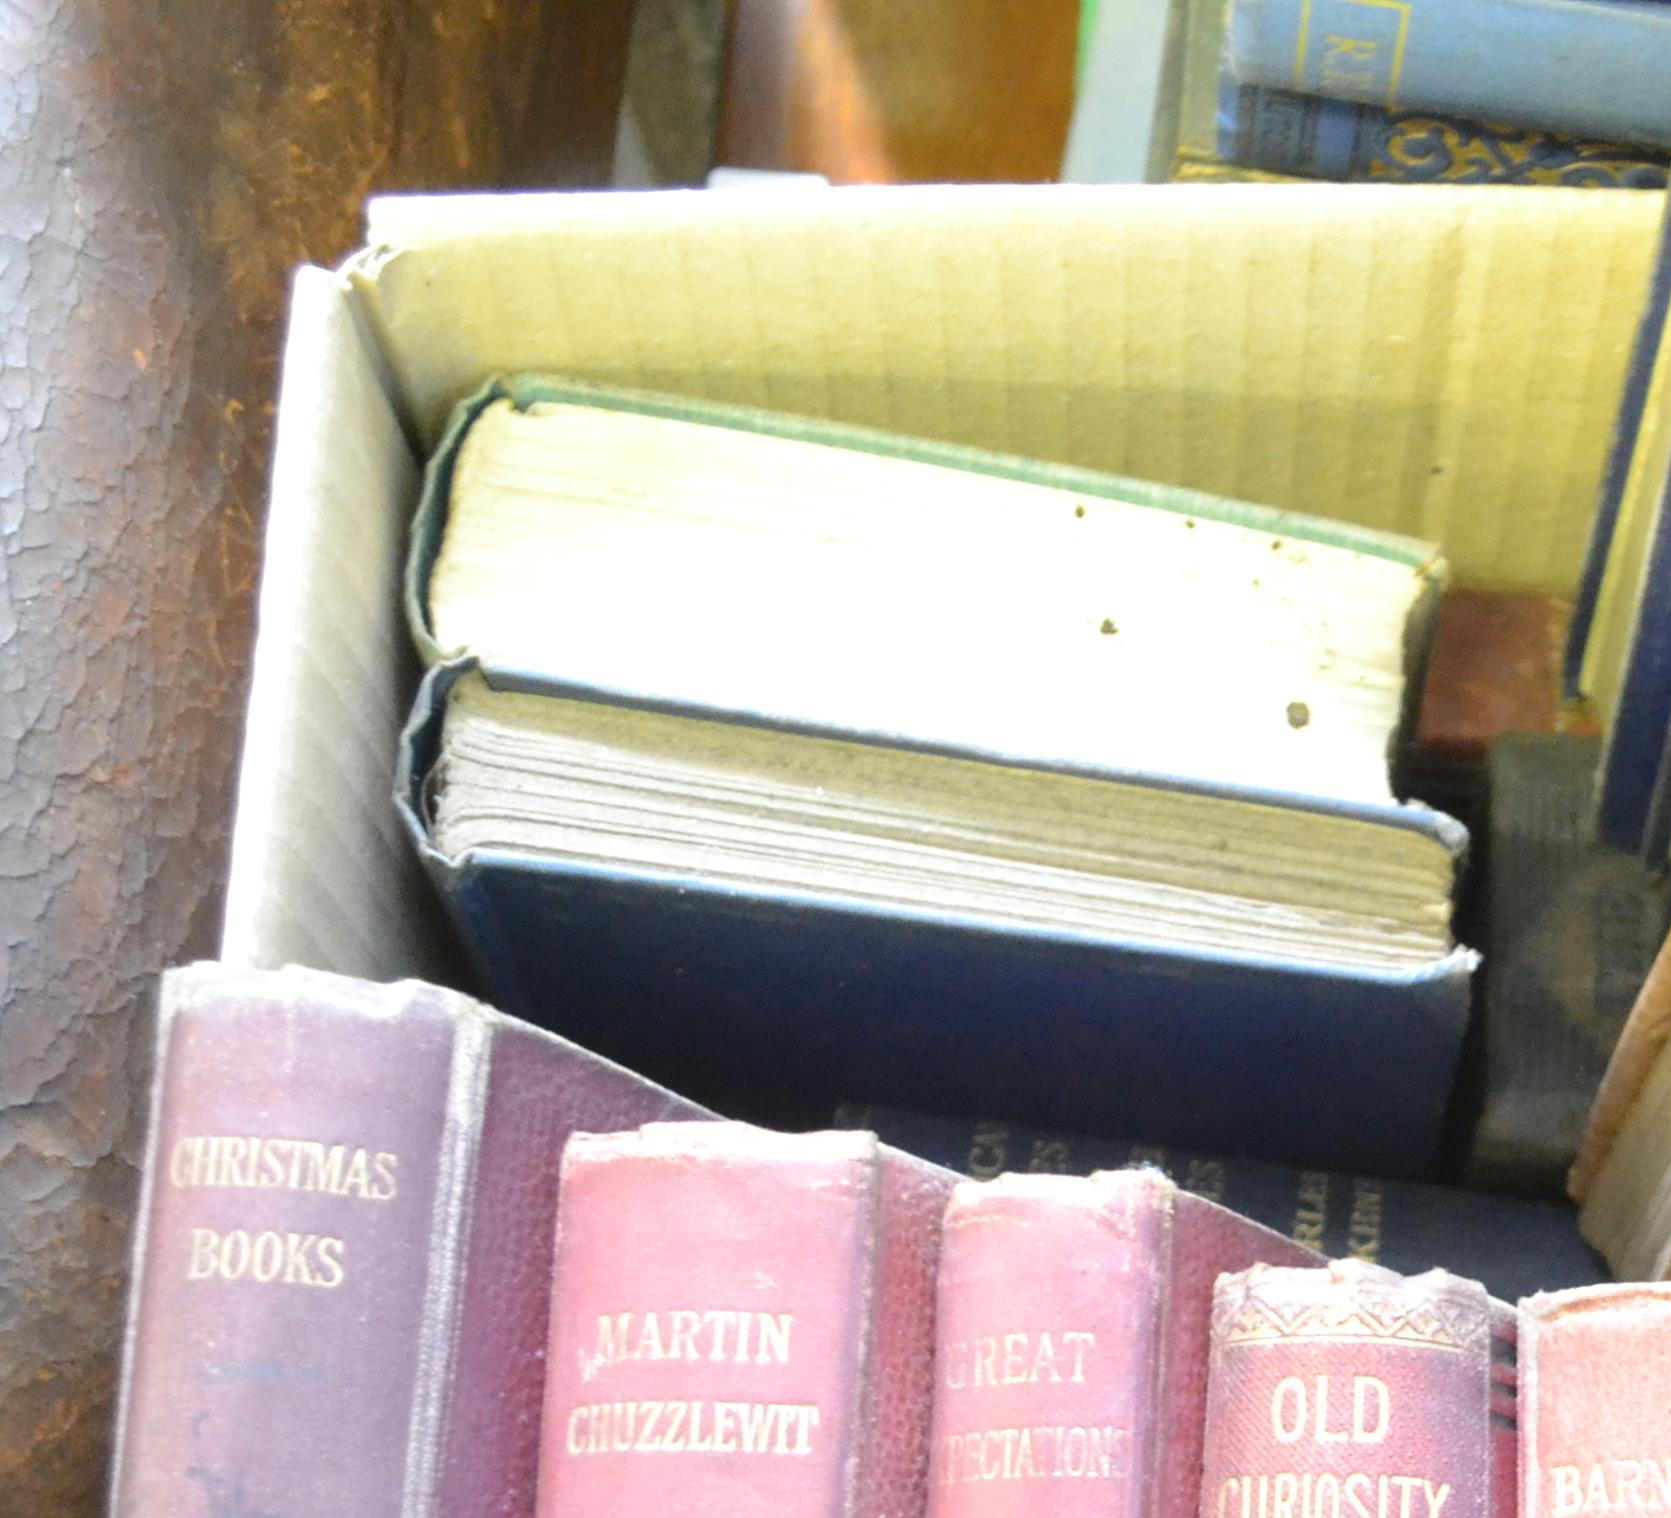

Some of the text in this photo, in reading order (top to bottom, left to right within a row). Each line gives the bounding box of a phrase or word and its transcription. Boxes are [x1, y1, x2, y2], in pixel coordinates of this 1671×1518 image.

[170, 1135, 399, 1201] CHRISTMAS
[186, 1227, 345, 1288] BOOKS
[597, 1310, 795, 1365] MARTIN
[567, 1400, 820, 1456] CHUZZLEWIT
[1272, 1375, 1391, 1443] OLD
